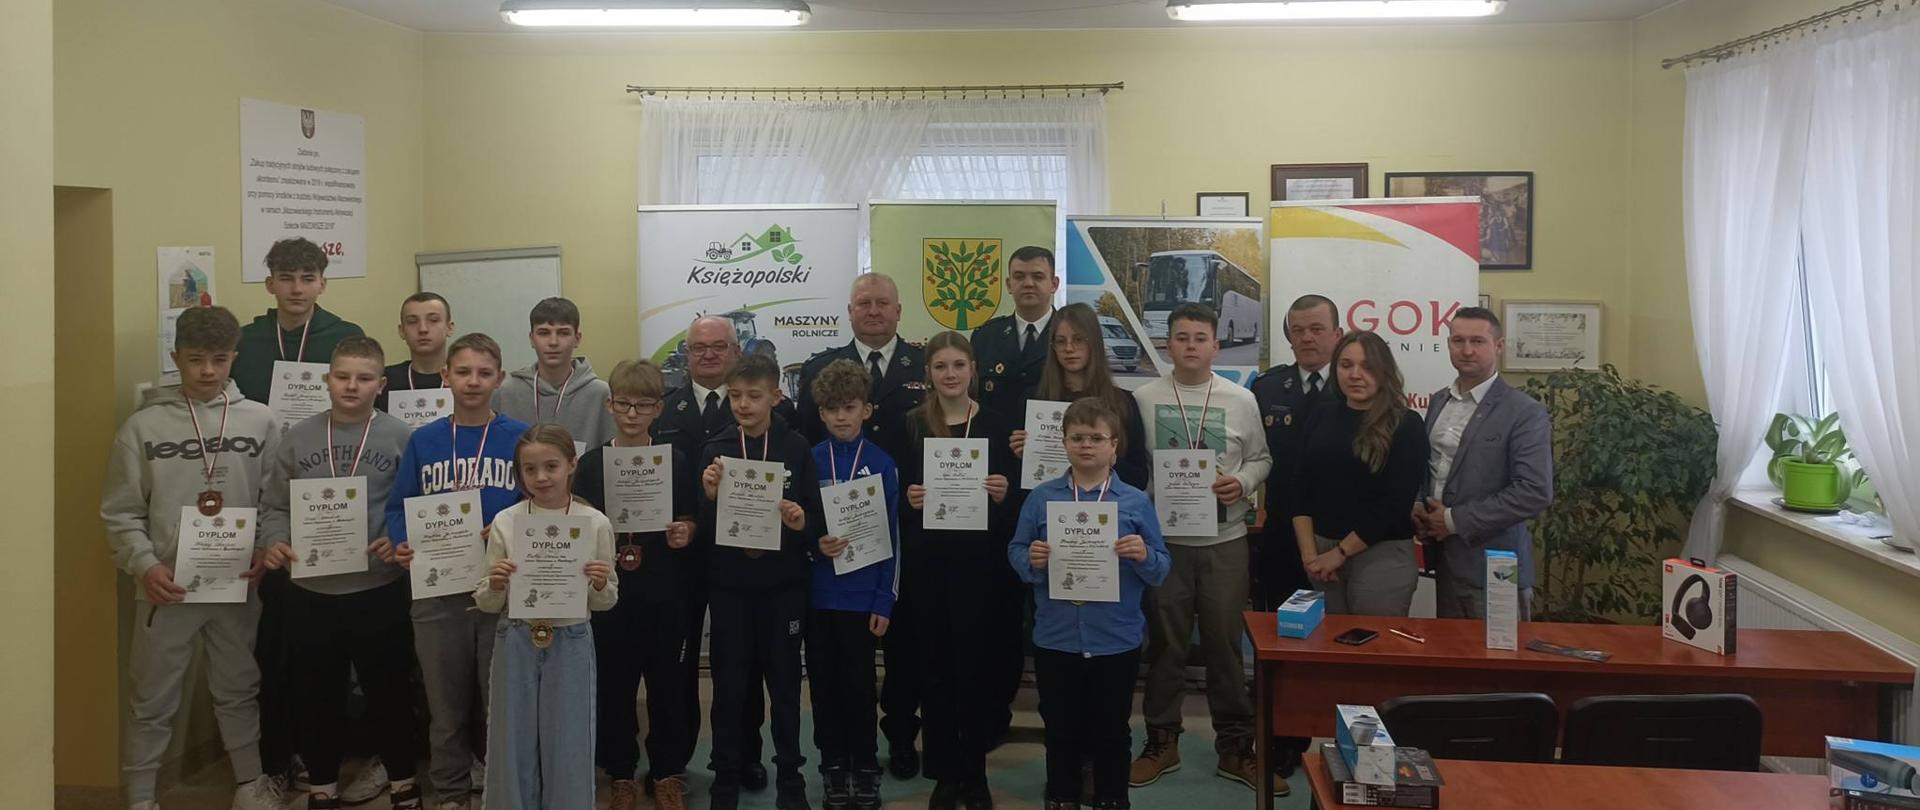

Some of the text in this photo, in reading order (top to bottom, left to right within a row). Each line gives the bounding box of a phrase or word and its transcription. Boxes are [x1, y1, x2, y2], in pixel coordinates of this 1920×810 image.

[686, 266, 812, 288] Księżopolski
[774, 316, 840, 326] MASZYNY
[792, 329, 839, 337] ROLNICZE
[1040, 424, 1063, 432] DYPLO
[144, 436, 266, 460] legacy
[299, 445, 392, 472] NORTHAND
[422, 457, 516, 495] COLORADO
[620, 468, 655, 476] DYPLOM
[734, 481, 766, 490] DYPLOM
[309, 503, 348, 511] DYPLOM
[840, 500, 870, 514] DYPLOM
[425, 518, 463, 529] DYPLOM
[1064, 527, 1100, 535] DYPLOM
